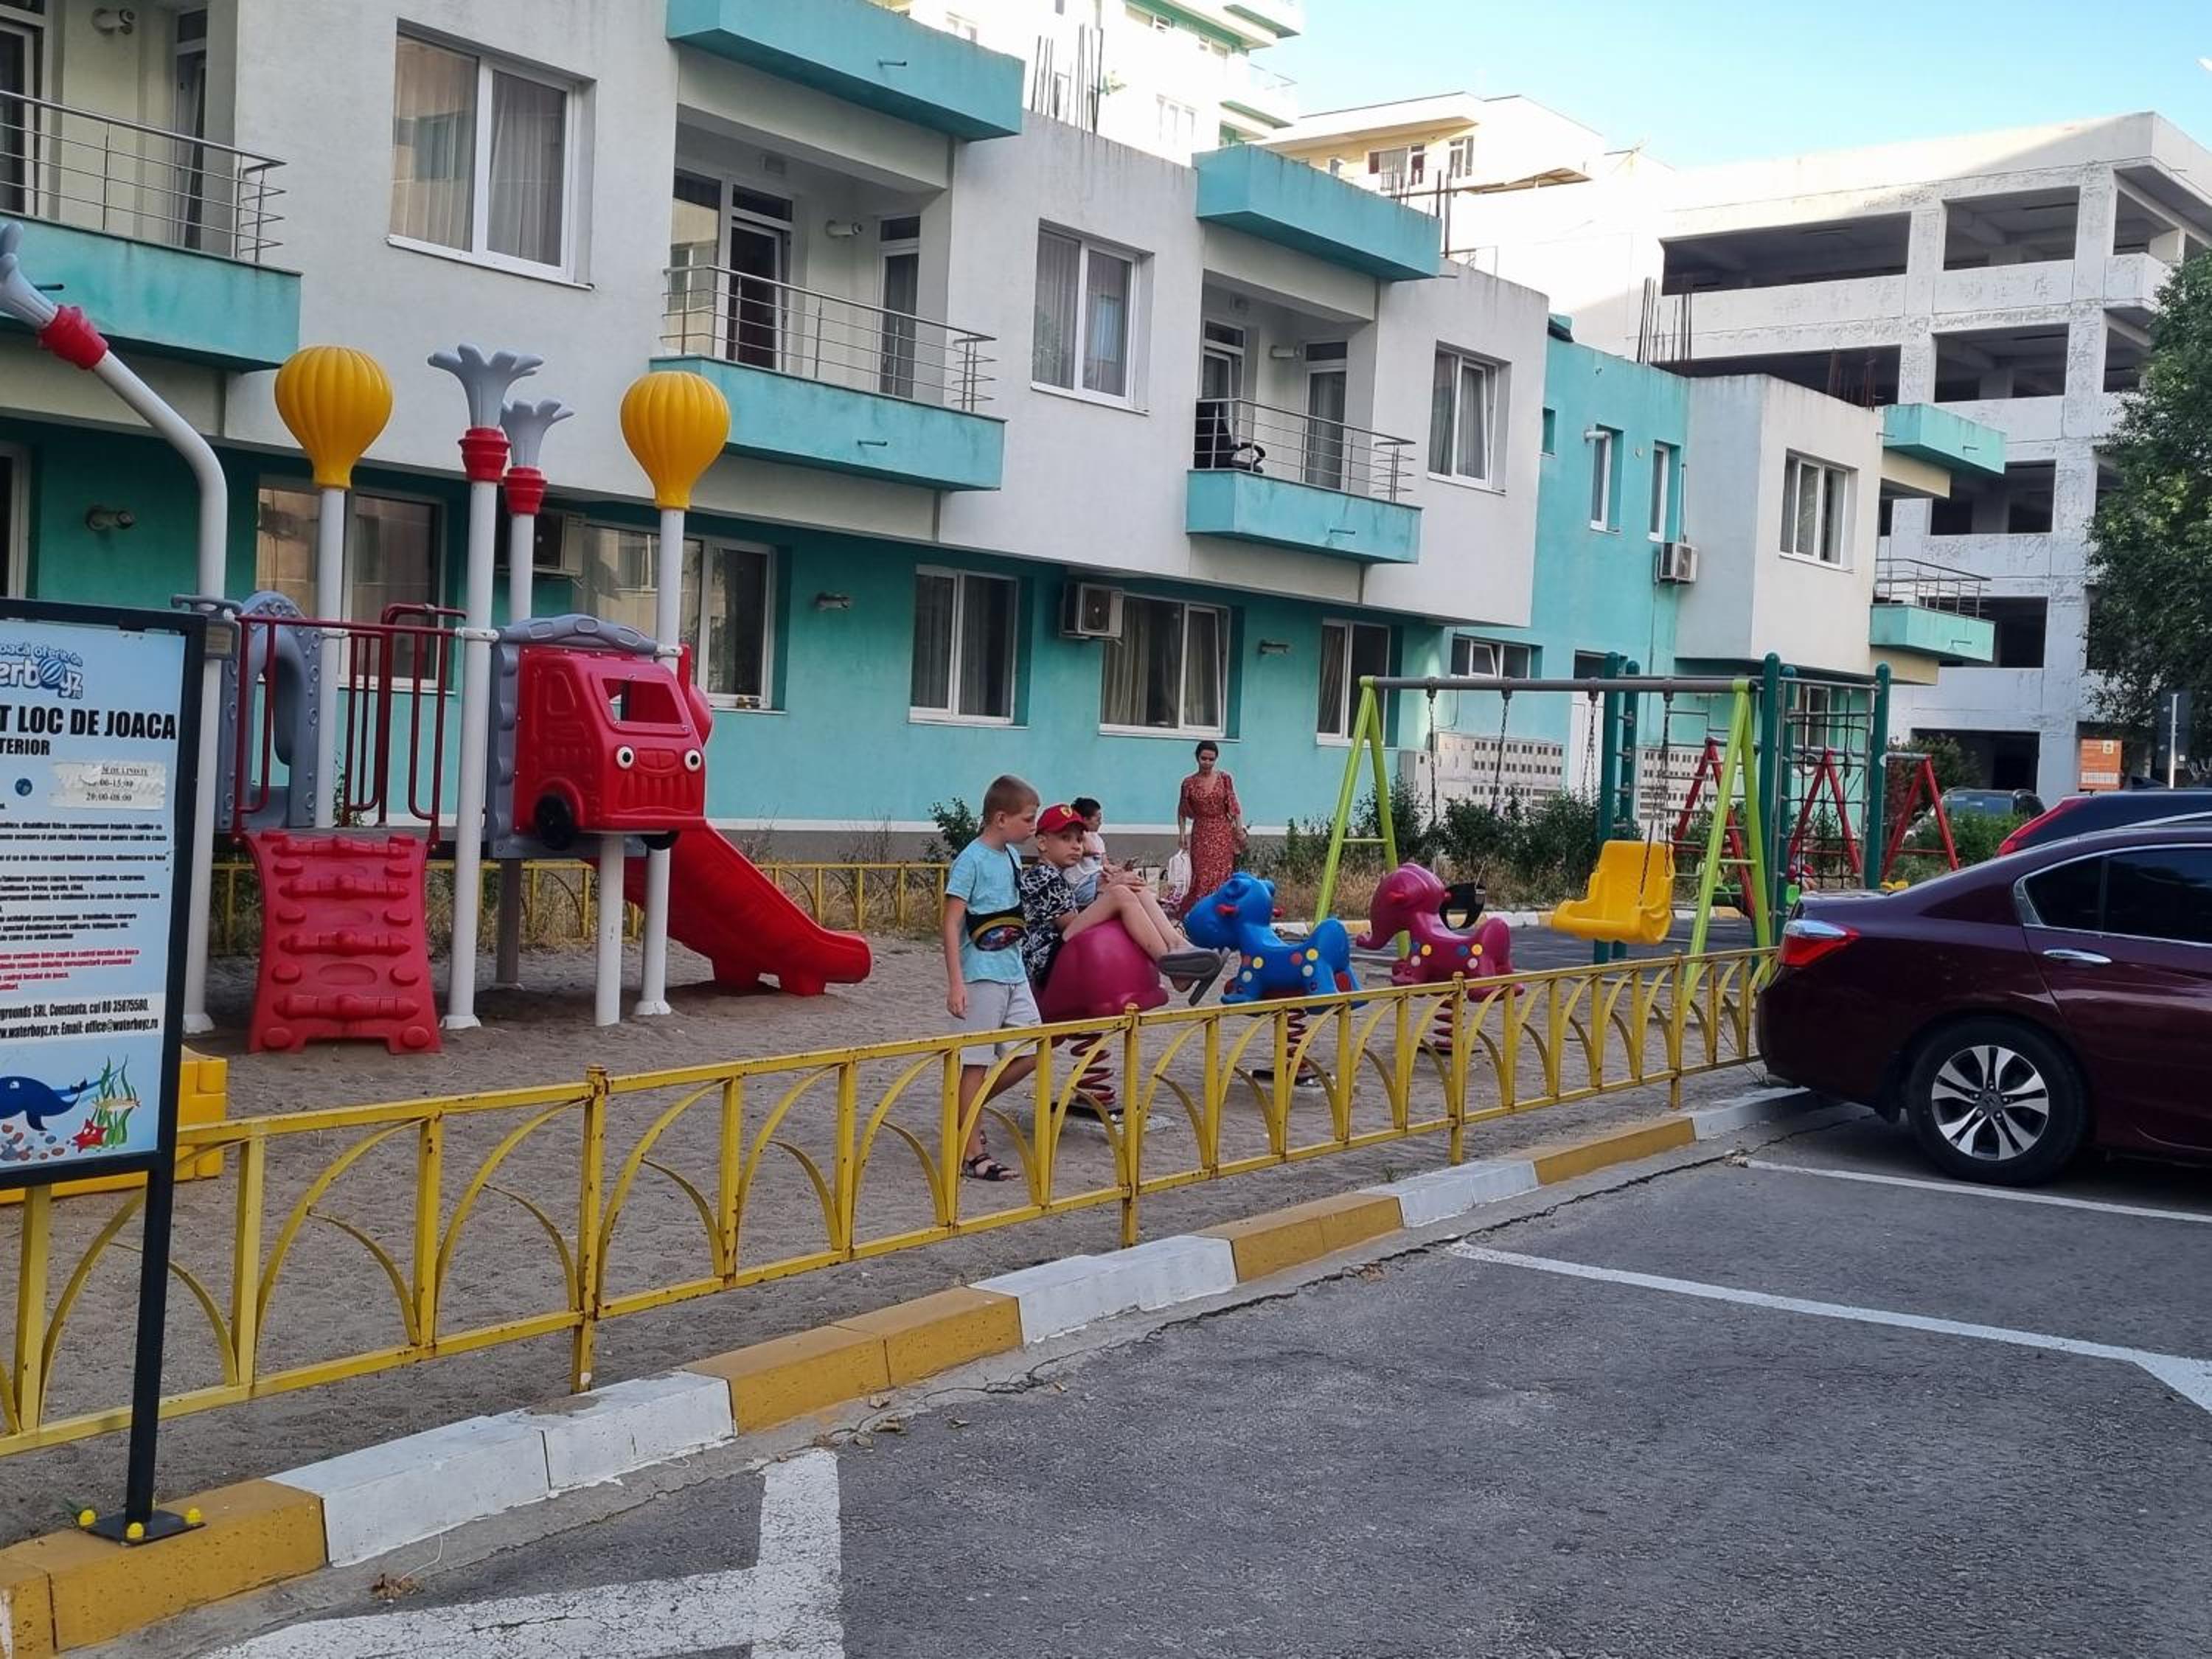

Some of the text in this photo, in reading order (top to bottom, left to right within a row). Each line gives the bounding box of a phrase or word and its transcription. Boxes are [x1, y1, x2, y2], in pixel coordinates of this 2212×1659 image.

[18, 706, 63, 734] LOC
[70, 709, 100, 736] DE
[105, 711, 176, 740] JOACA
